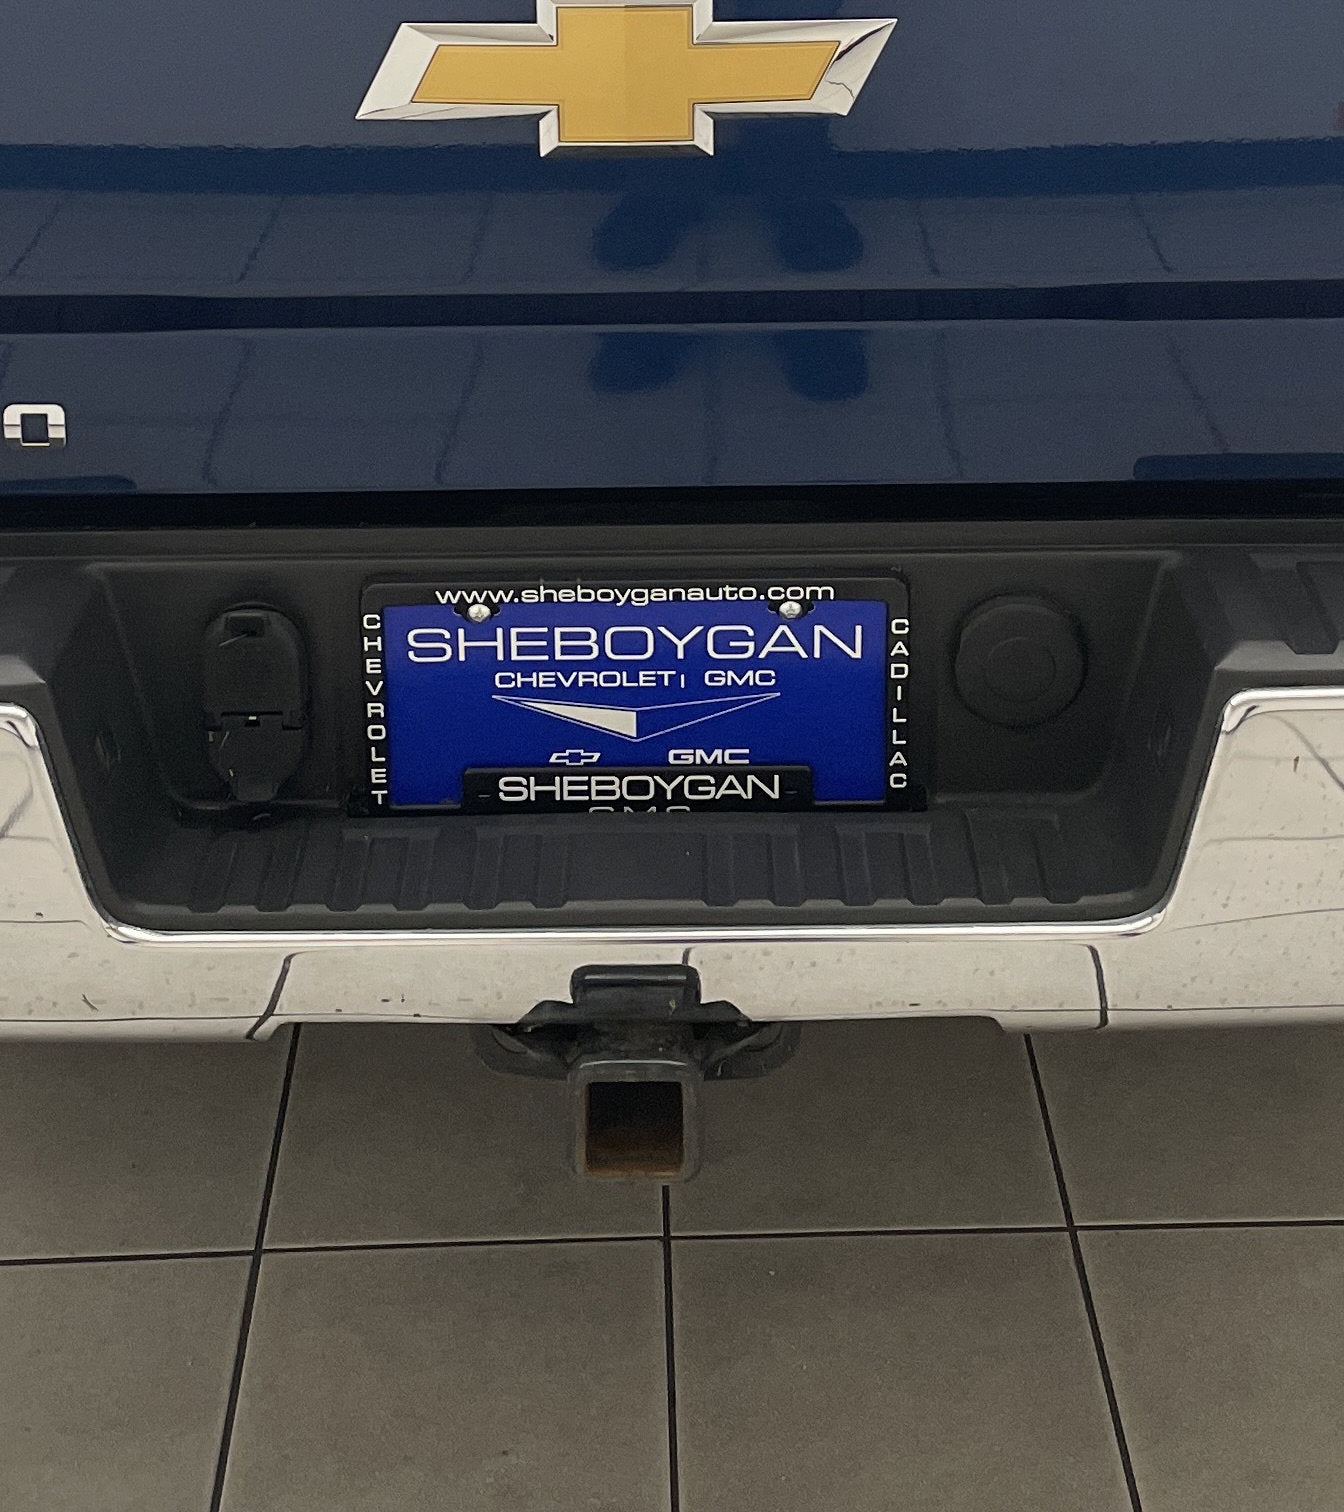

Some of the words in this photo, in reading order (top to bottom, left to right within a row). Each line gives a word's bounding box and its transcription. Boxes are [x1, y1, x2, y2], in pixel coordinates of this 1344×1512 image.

[435, 584, 835, 606] www.sheboyganauto.com
[407, 624, 863, 663] SHEBOYGAN
[494, 670, 676, 689] CHEVROLET
[704, 669, 776, 687] GMC
[362, 614, 388, 805] CHEVROLET
[888, 618, 910, 789] CADILLAC
[668, 748, 750, 765] GMC
[498, 774, 780, 802] SHEBOYGAN
